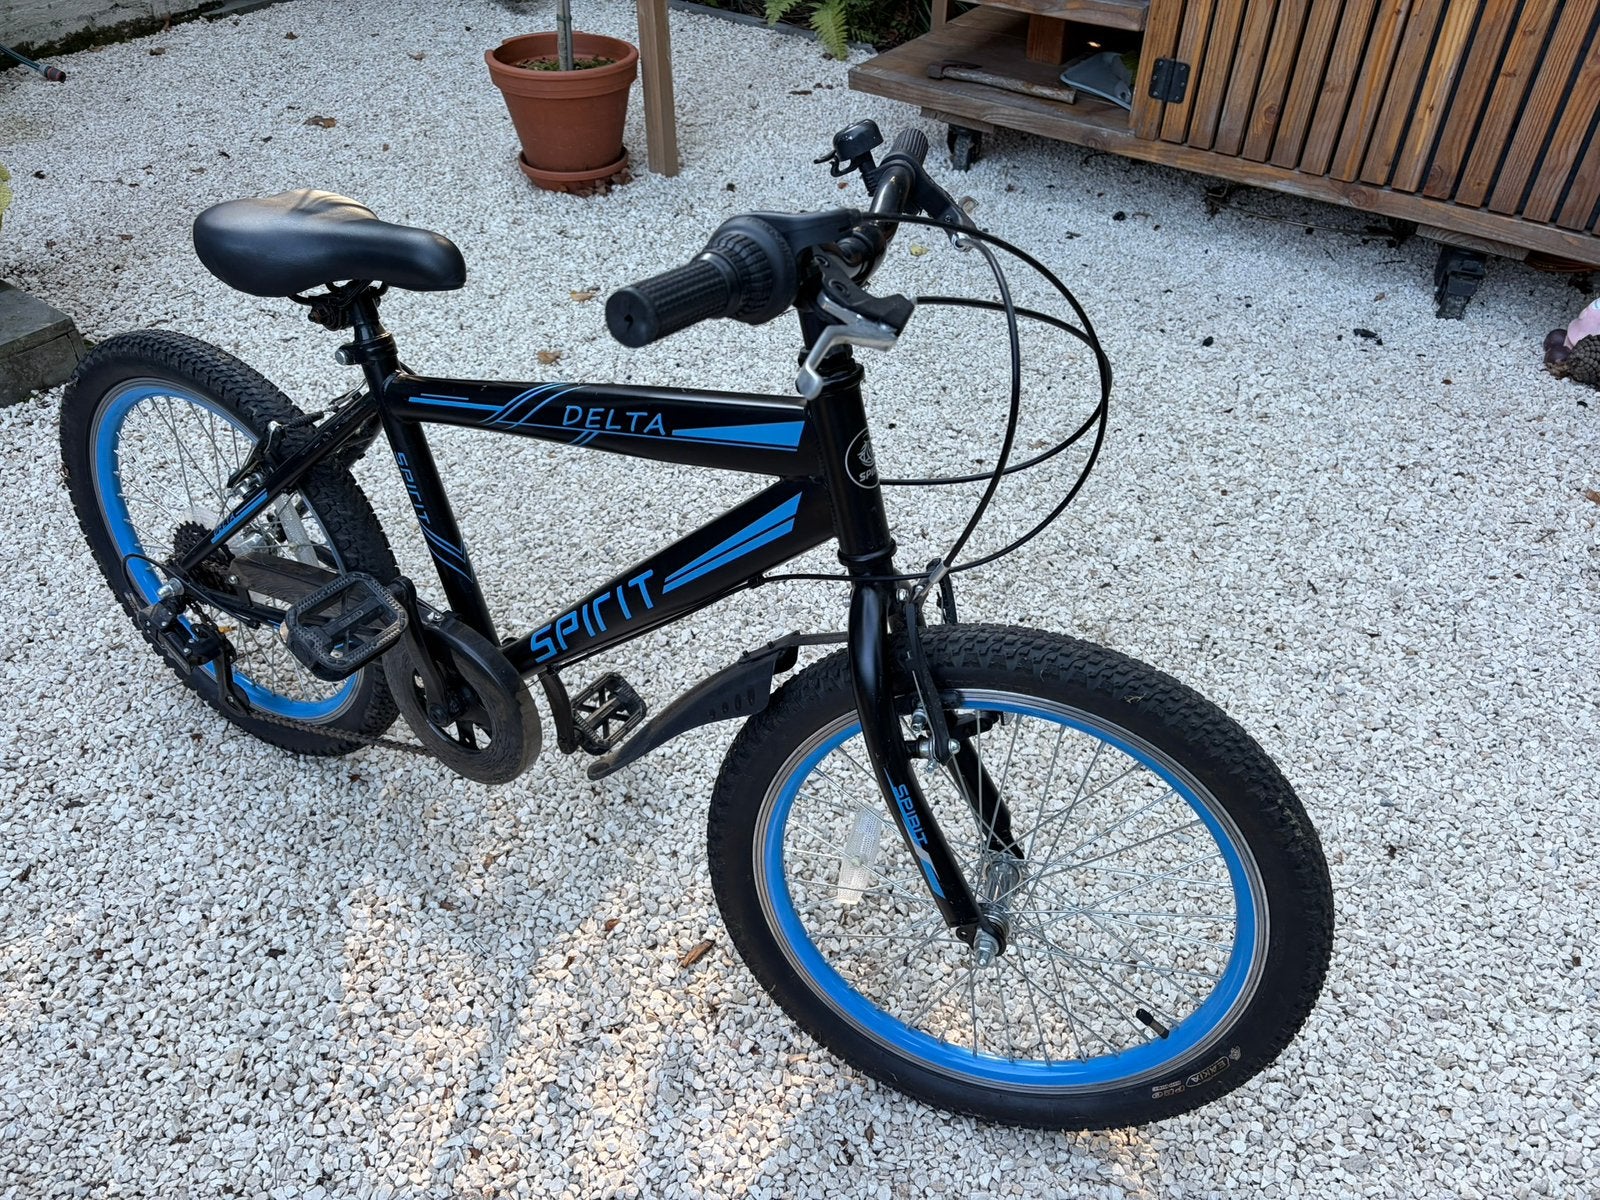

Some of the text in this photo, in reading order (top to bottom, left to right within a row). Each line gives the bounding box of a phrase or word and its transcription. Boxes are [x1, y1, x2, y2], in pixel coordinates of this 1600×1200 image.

[562, 405, 666, 436] DELTA
[395, 452, 430, 524] SPIRIT
[530, 569, 654, 663] SPIRIT
[893, 784, 928, 845] SPIRIT
